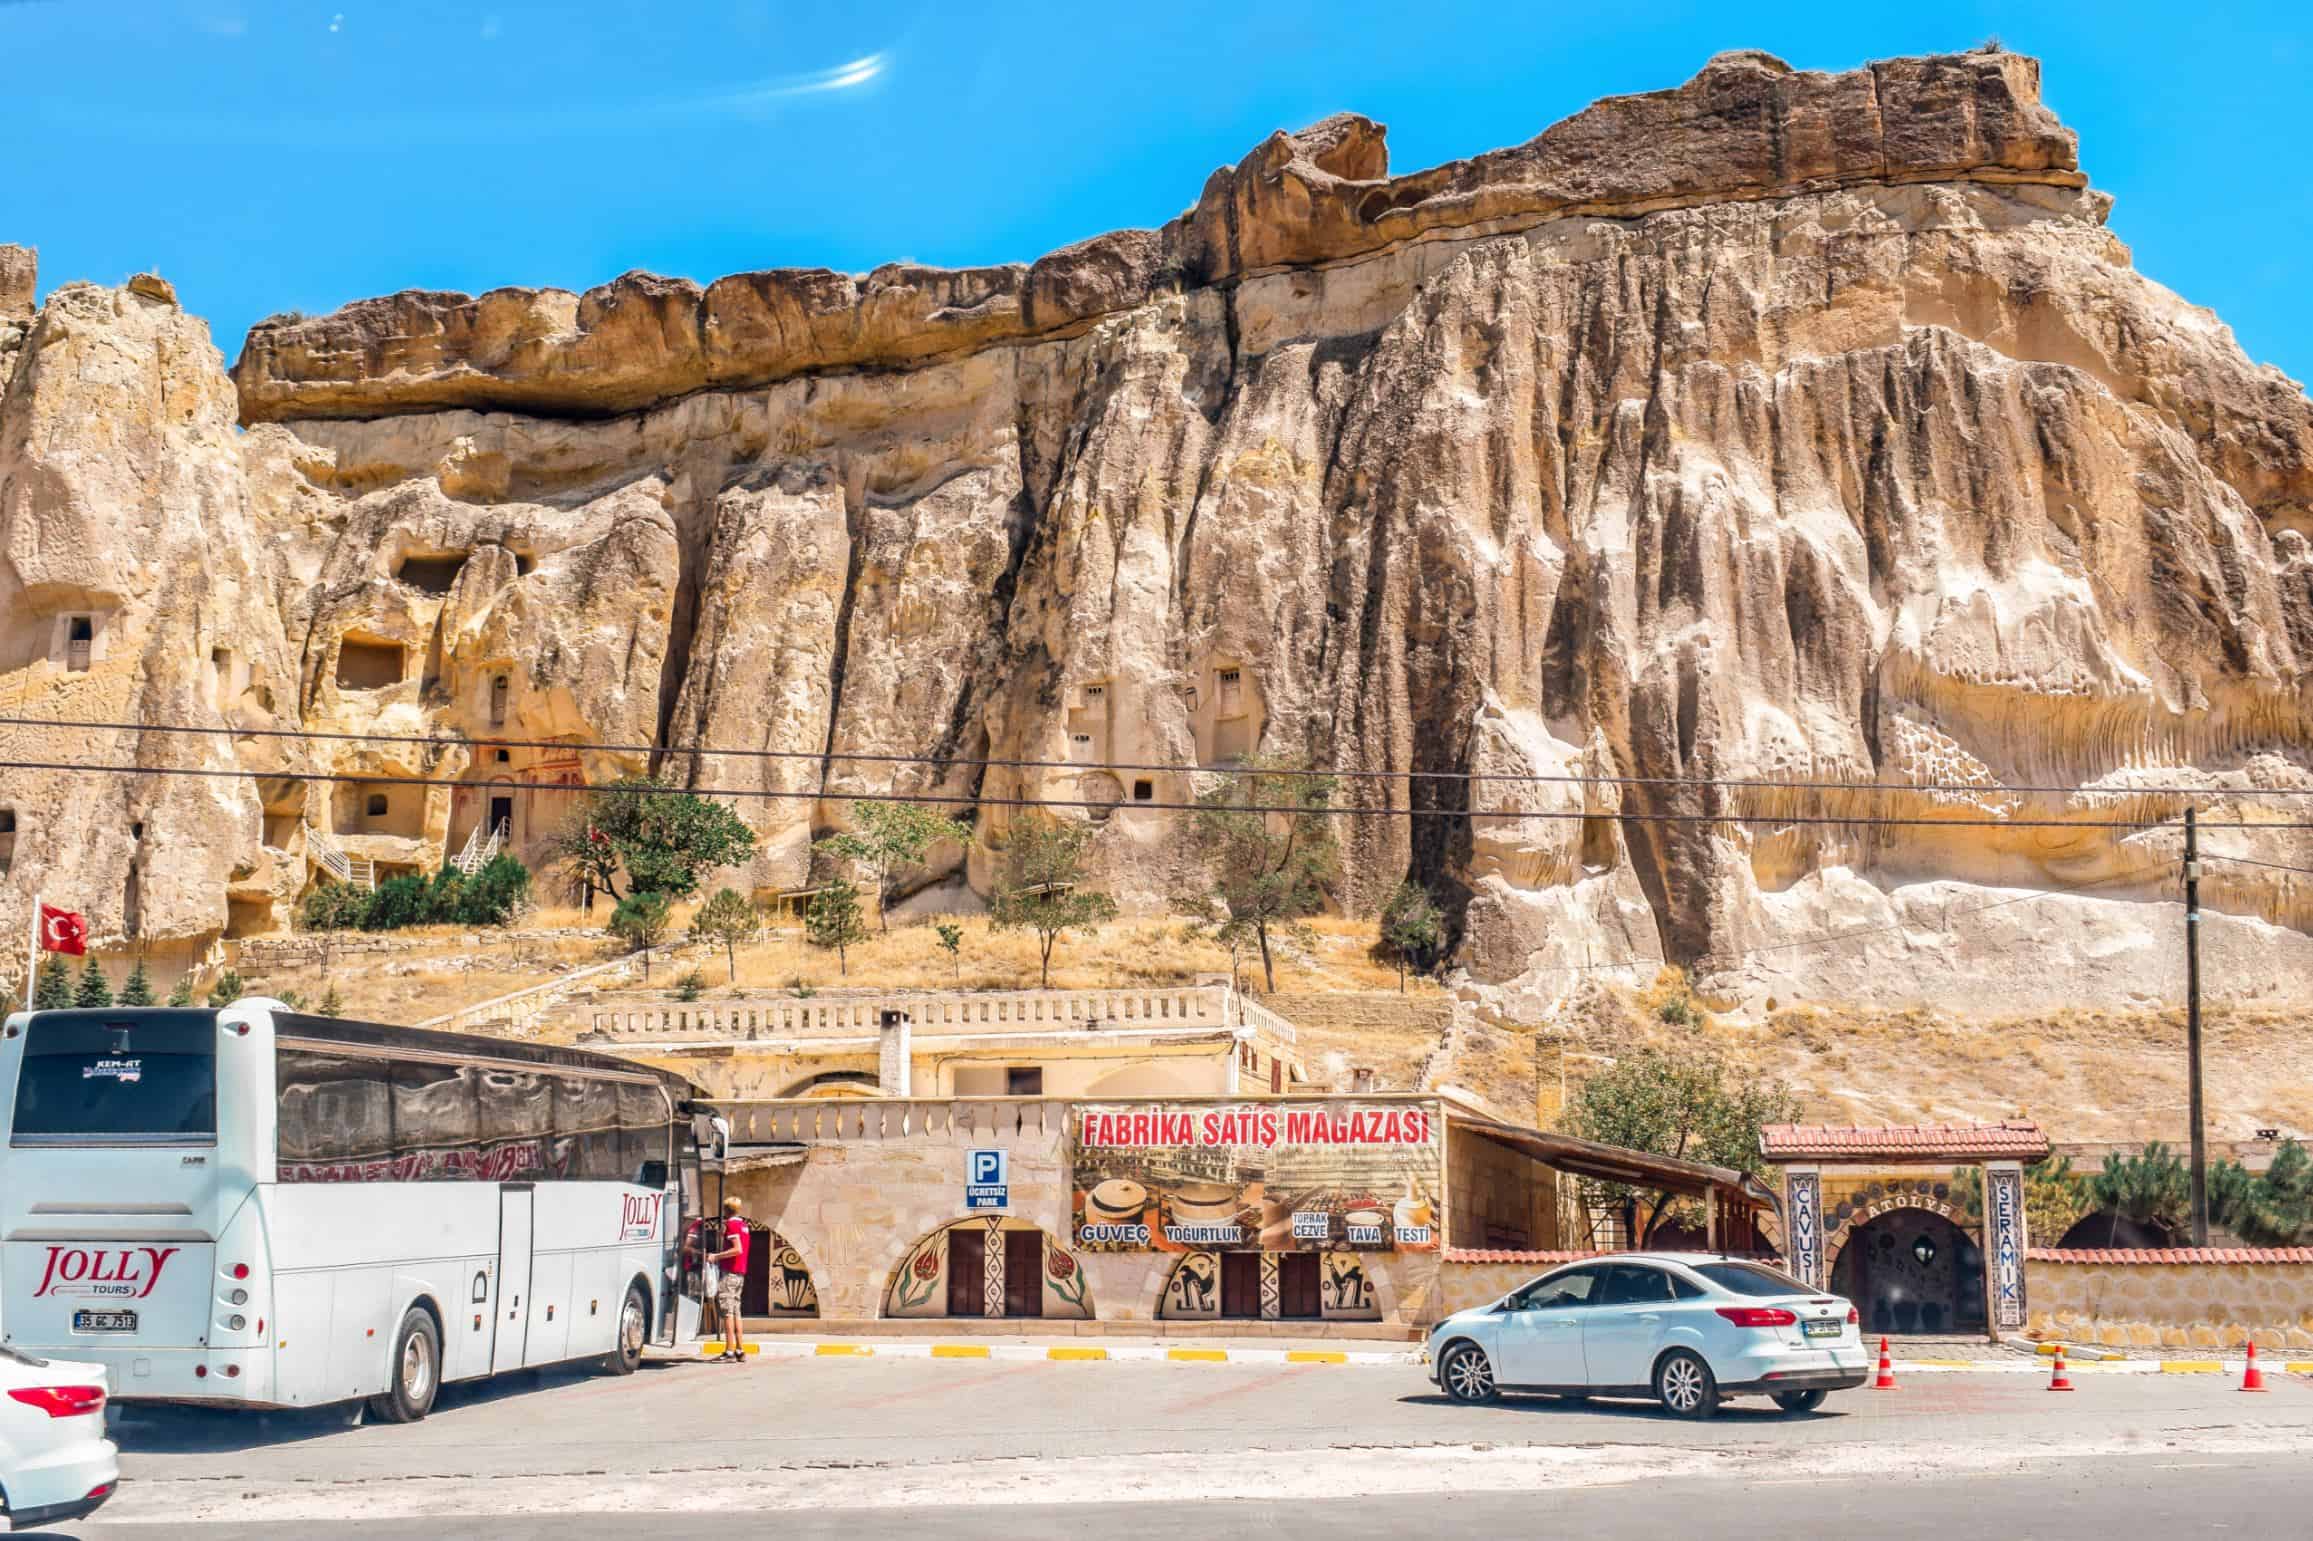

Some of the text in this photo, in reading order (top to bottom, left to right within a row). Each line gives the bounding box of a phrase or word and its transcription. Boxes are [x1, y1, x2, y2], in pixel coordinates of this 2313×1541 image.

[1084, 1107, 1194, 1146] FABRİKA
[976, 1154, 997, 1181] P
[619, 1193, 662, 1240] JOLLY
[1294, 1213, 1328, 1225] TOPRAK
[1082, 1224, 1149, 1244] GÜVEÇ
[1166, 1226, 1240, 1241] YOĞURTLUK
[1294, 1225, 1327, 1237] CEZVE
[1350, 1228, 1380, 1241] TAVA
[1395, 1226, 1429, 1241] TESTİ
[33, 1246, 180, 1298] JOLLY
[92, 1285, 130, 1295] TOURS
